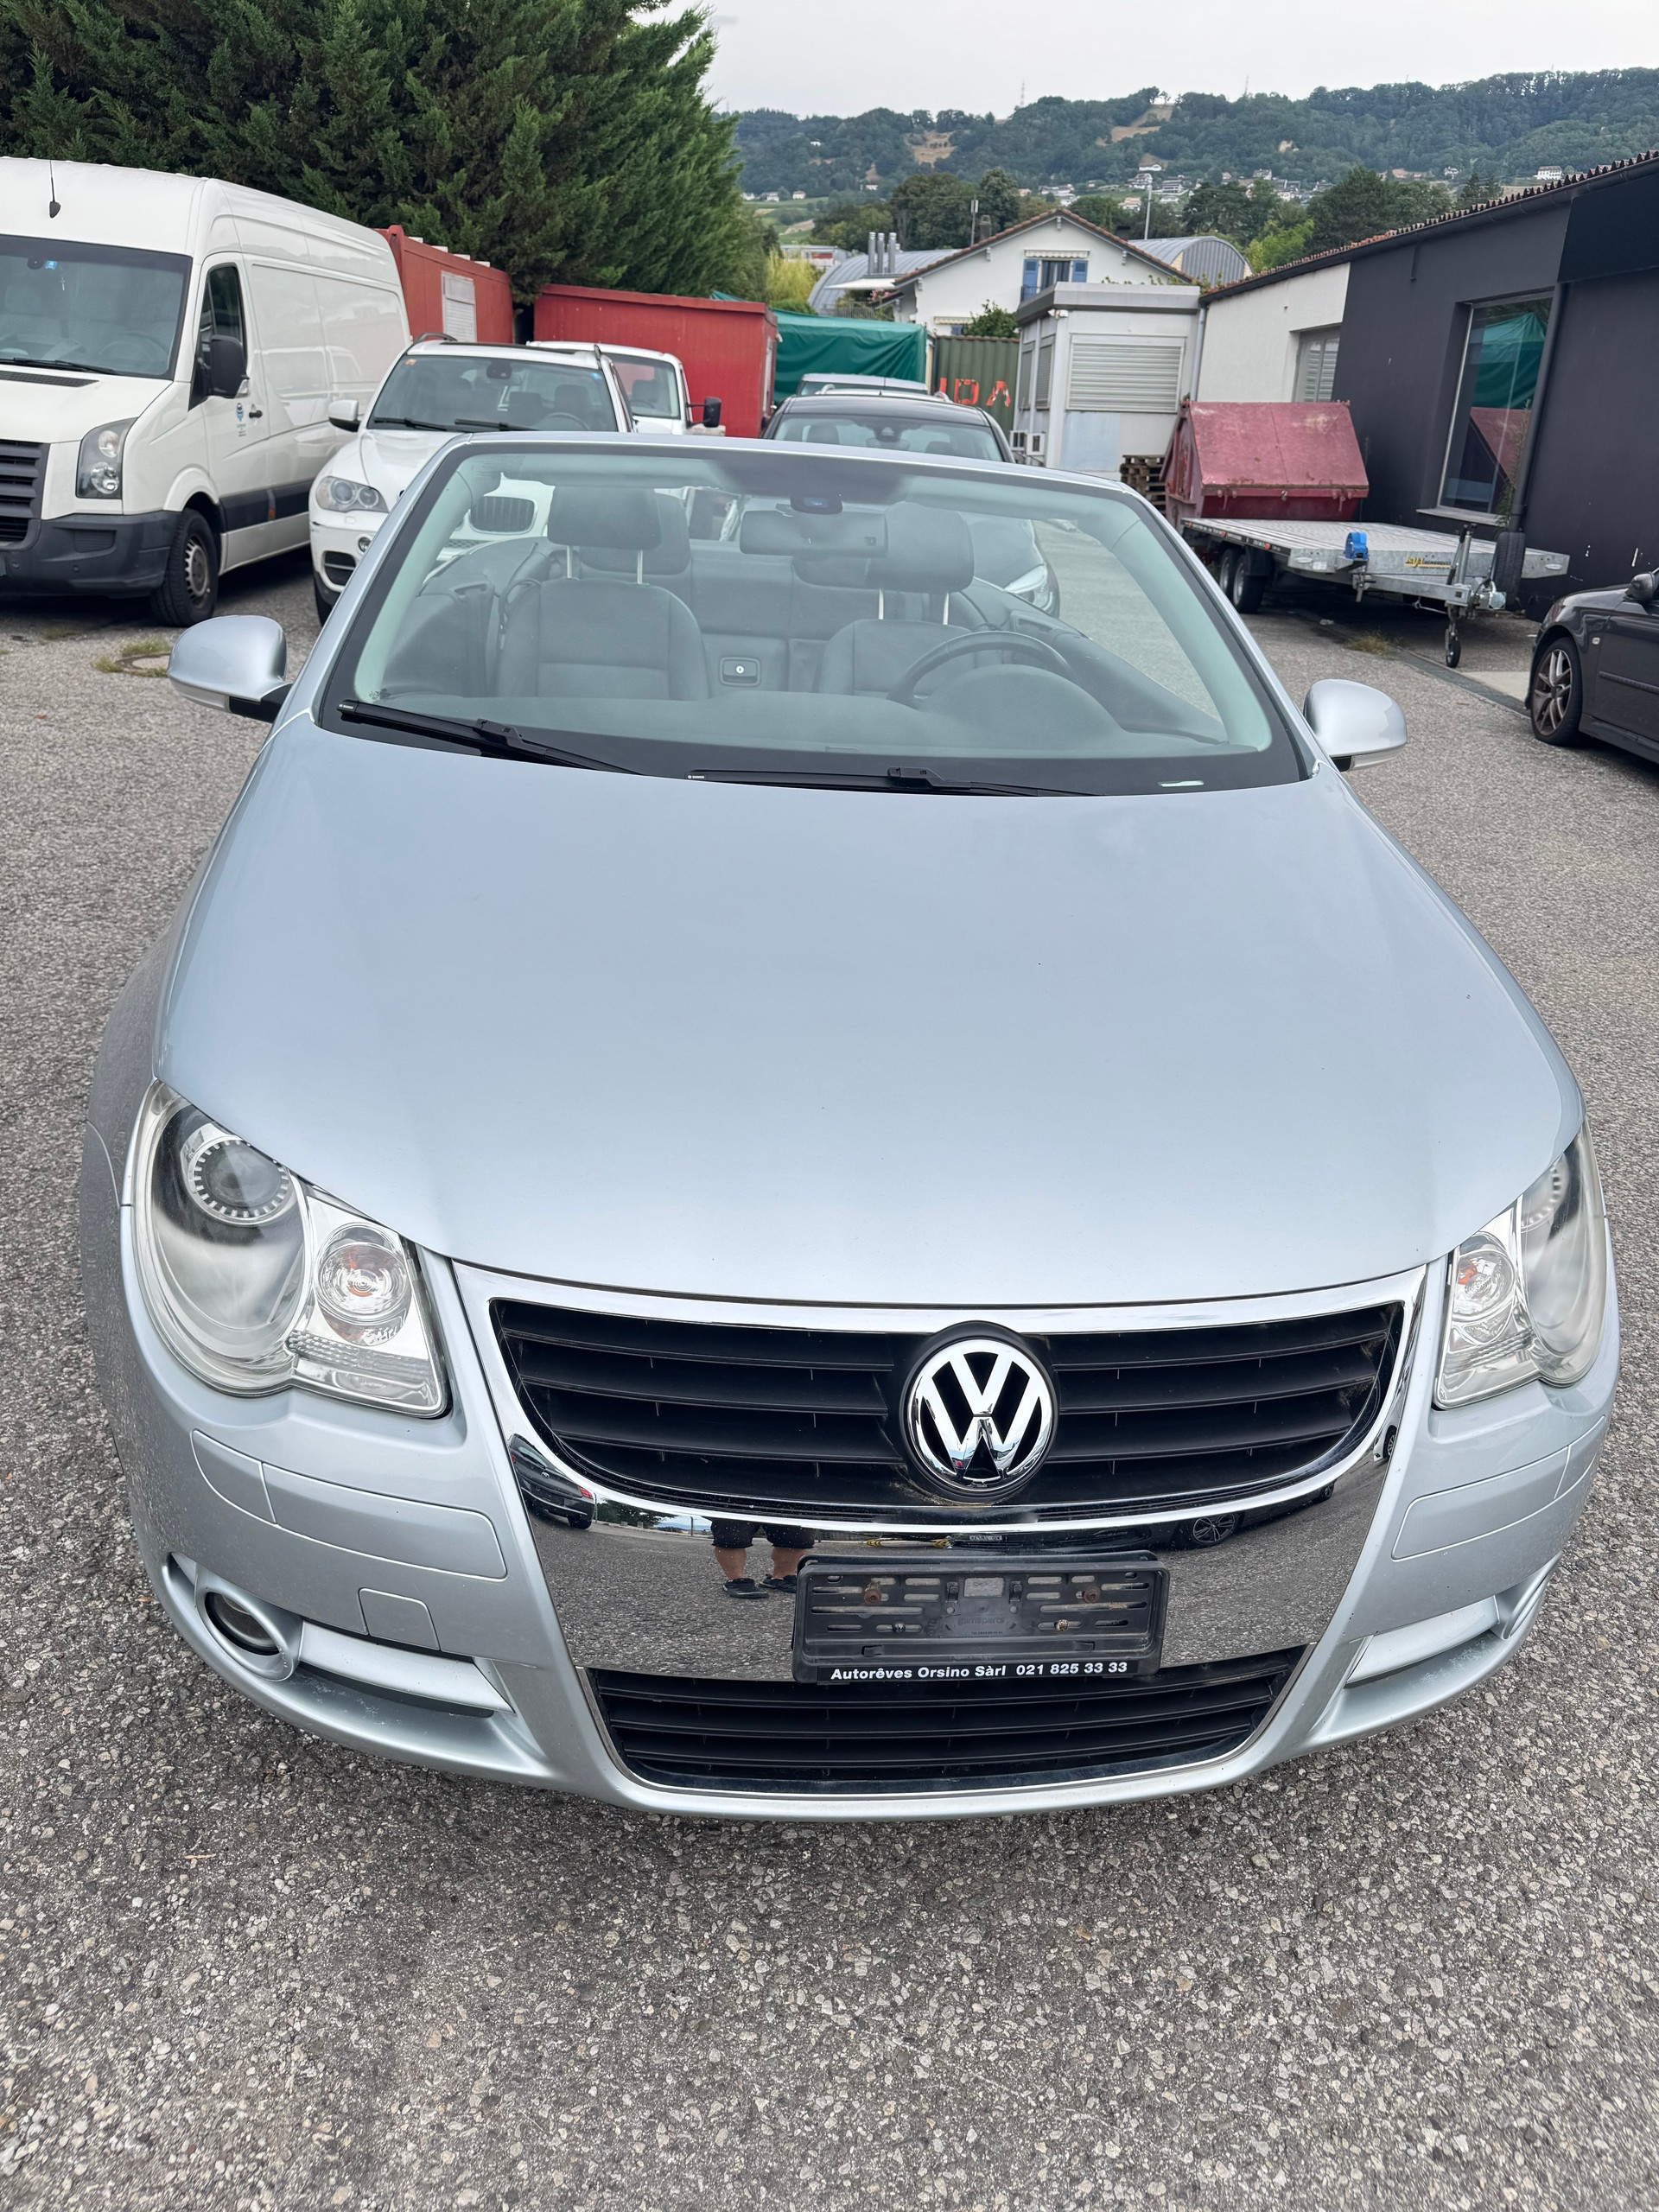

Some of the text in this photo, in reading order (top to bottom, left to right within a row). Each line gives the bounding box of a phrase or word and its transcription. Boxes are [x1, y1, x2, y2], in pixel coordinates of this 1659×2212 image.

[830, 1662, 1128, 1680] Autorêves Orsino Sàrl 021 825 33 33
